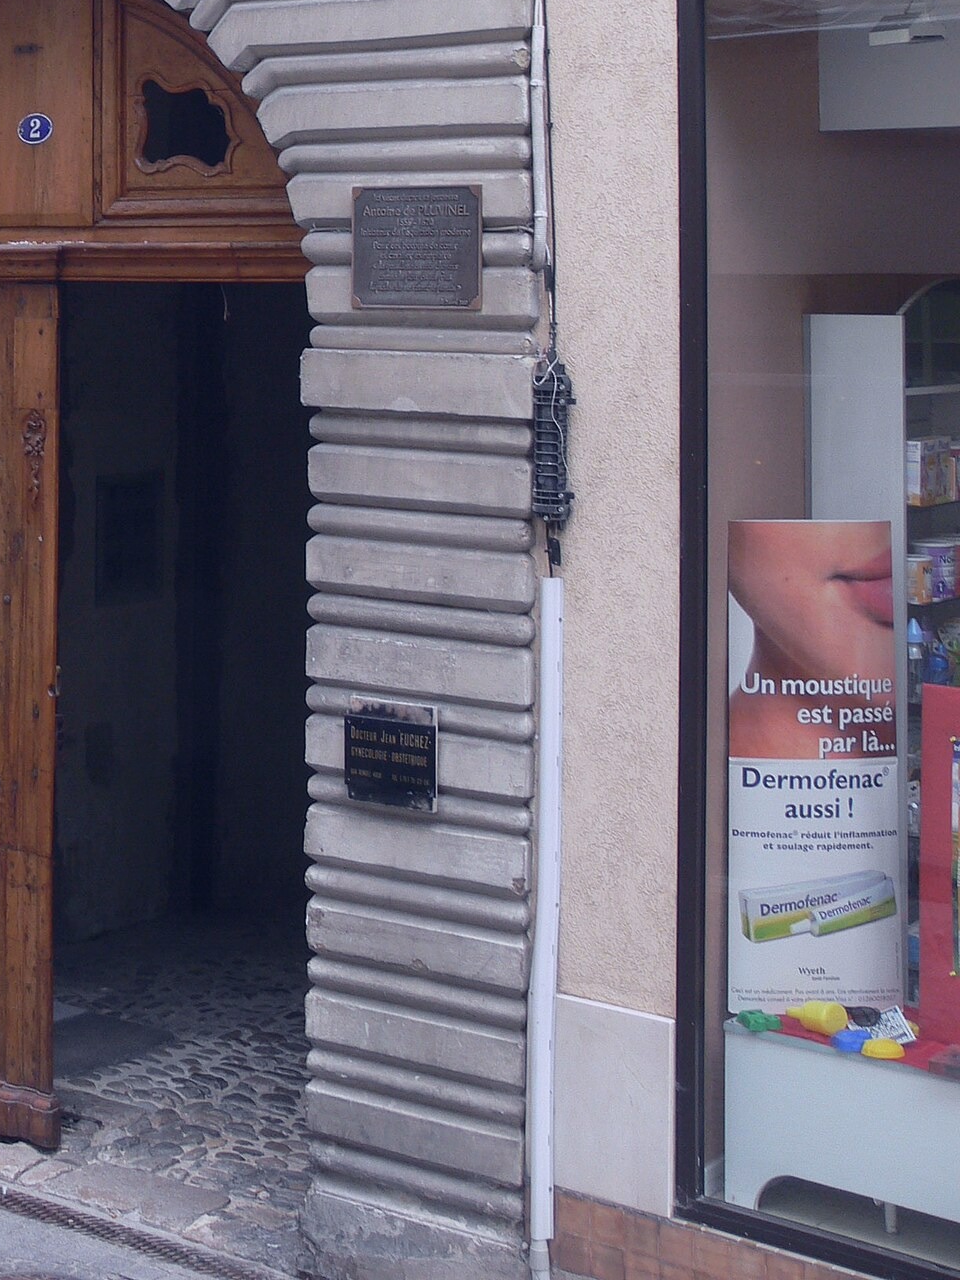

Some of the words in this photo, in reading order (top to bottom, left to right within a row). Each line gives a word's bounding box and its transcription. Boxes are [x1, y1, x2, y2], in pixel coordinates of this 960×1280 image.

[30, 119, 40, 138] 2
[363, 205, 400, 216] Antoine
[403, 204, 416, 216] de
[418, 204, 470, 216] PLUVINEL
[740, 673, 776, 695] Un
[781, 672, 892, 700] moustique
[797, 707, 832, 724] est
[839, 701, 893, 730] passé
[350, 726, 377, 742] DOCTEUR
[380, 730, 396, 744] JEAN
[400, 733, 429, 750] FUCHEZ
[819, 737, 856, 758] par
[862, 731, 895, 752] là...
[784, 797, 840, 818] aussi
[848, 797, 854, 818] !
[800, 828, 831, 839] réduit
[834, 828, 898, 839] l'inflammation
[763, 842, 774, 850] et
[777, 842, 815, 852] soulage
[816, 842, 874, 852] rapidement.
[759, 891, 838, 917] Dermofenac
[798, 966, 826, 976] Wyeth
